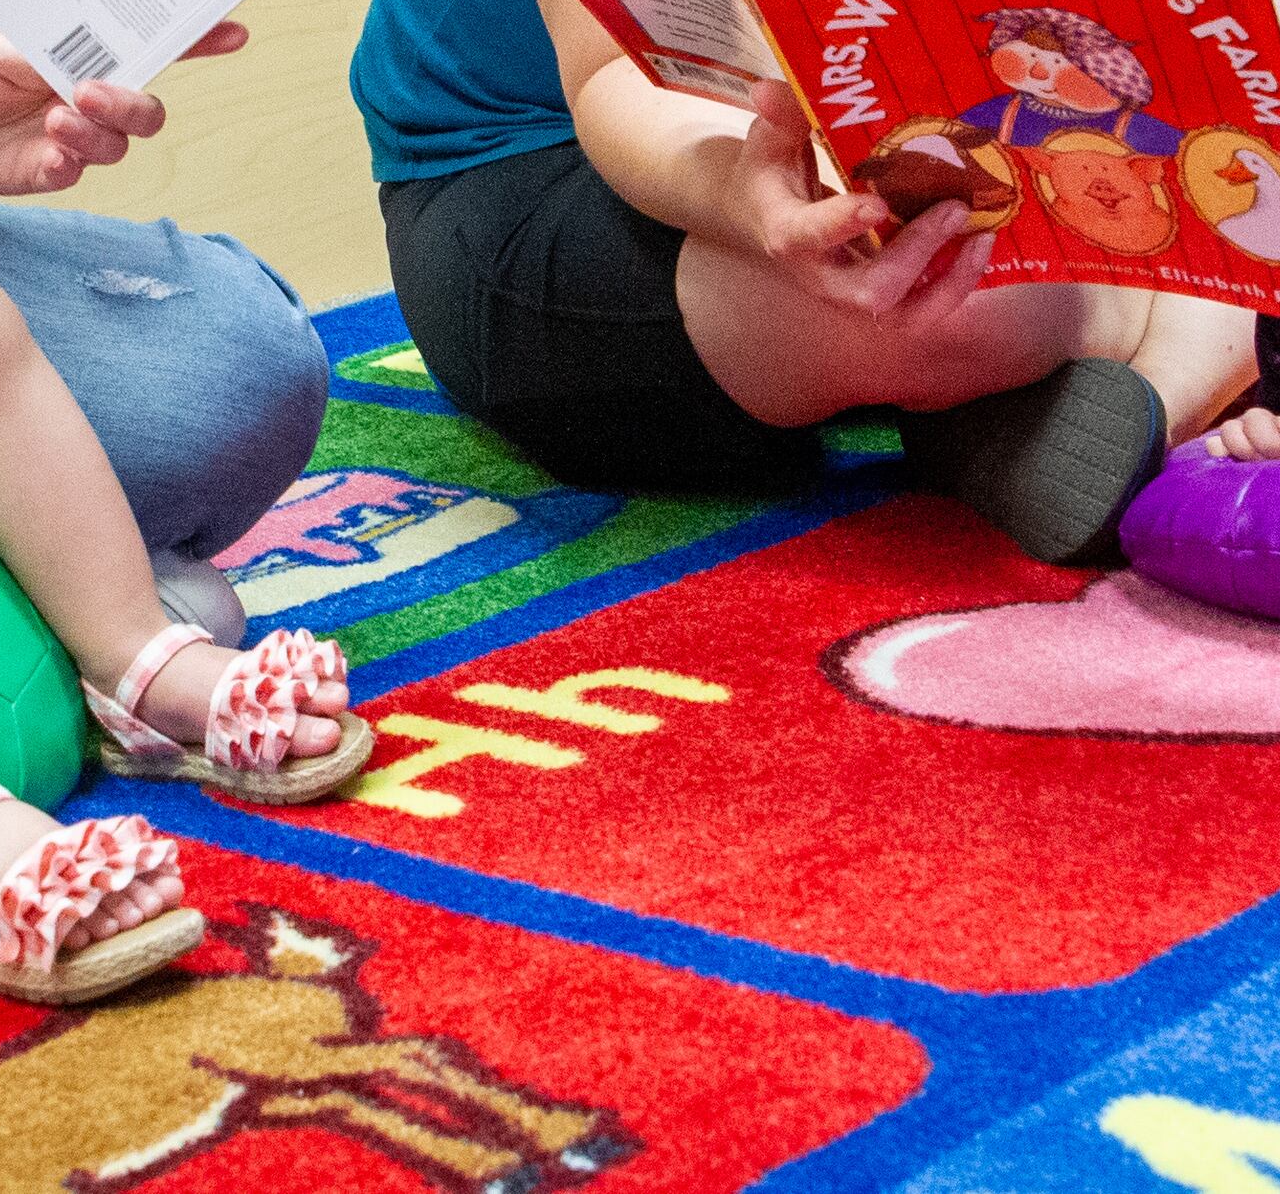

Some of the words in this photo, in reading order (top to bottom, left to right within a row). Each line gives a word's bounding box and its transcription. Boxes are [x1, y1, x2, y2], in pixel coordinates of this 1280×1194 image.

[820, 36, 886, 130] MRS.
[1159, 265, 1267, 300] Elizabeth
[348, 666, 732, 818] Hh
